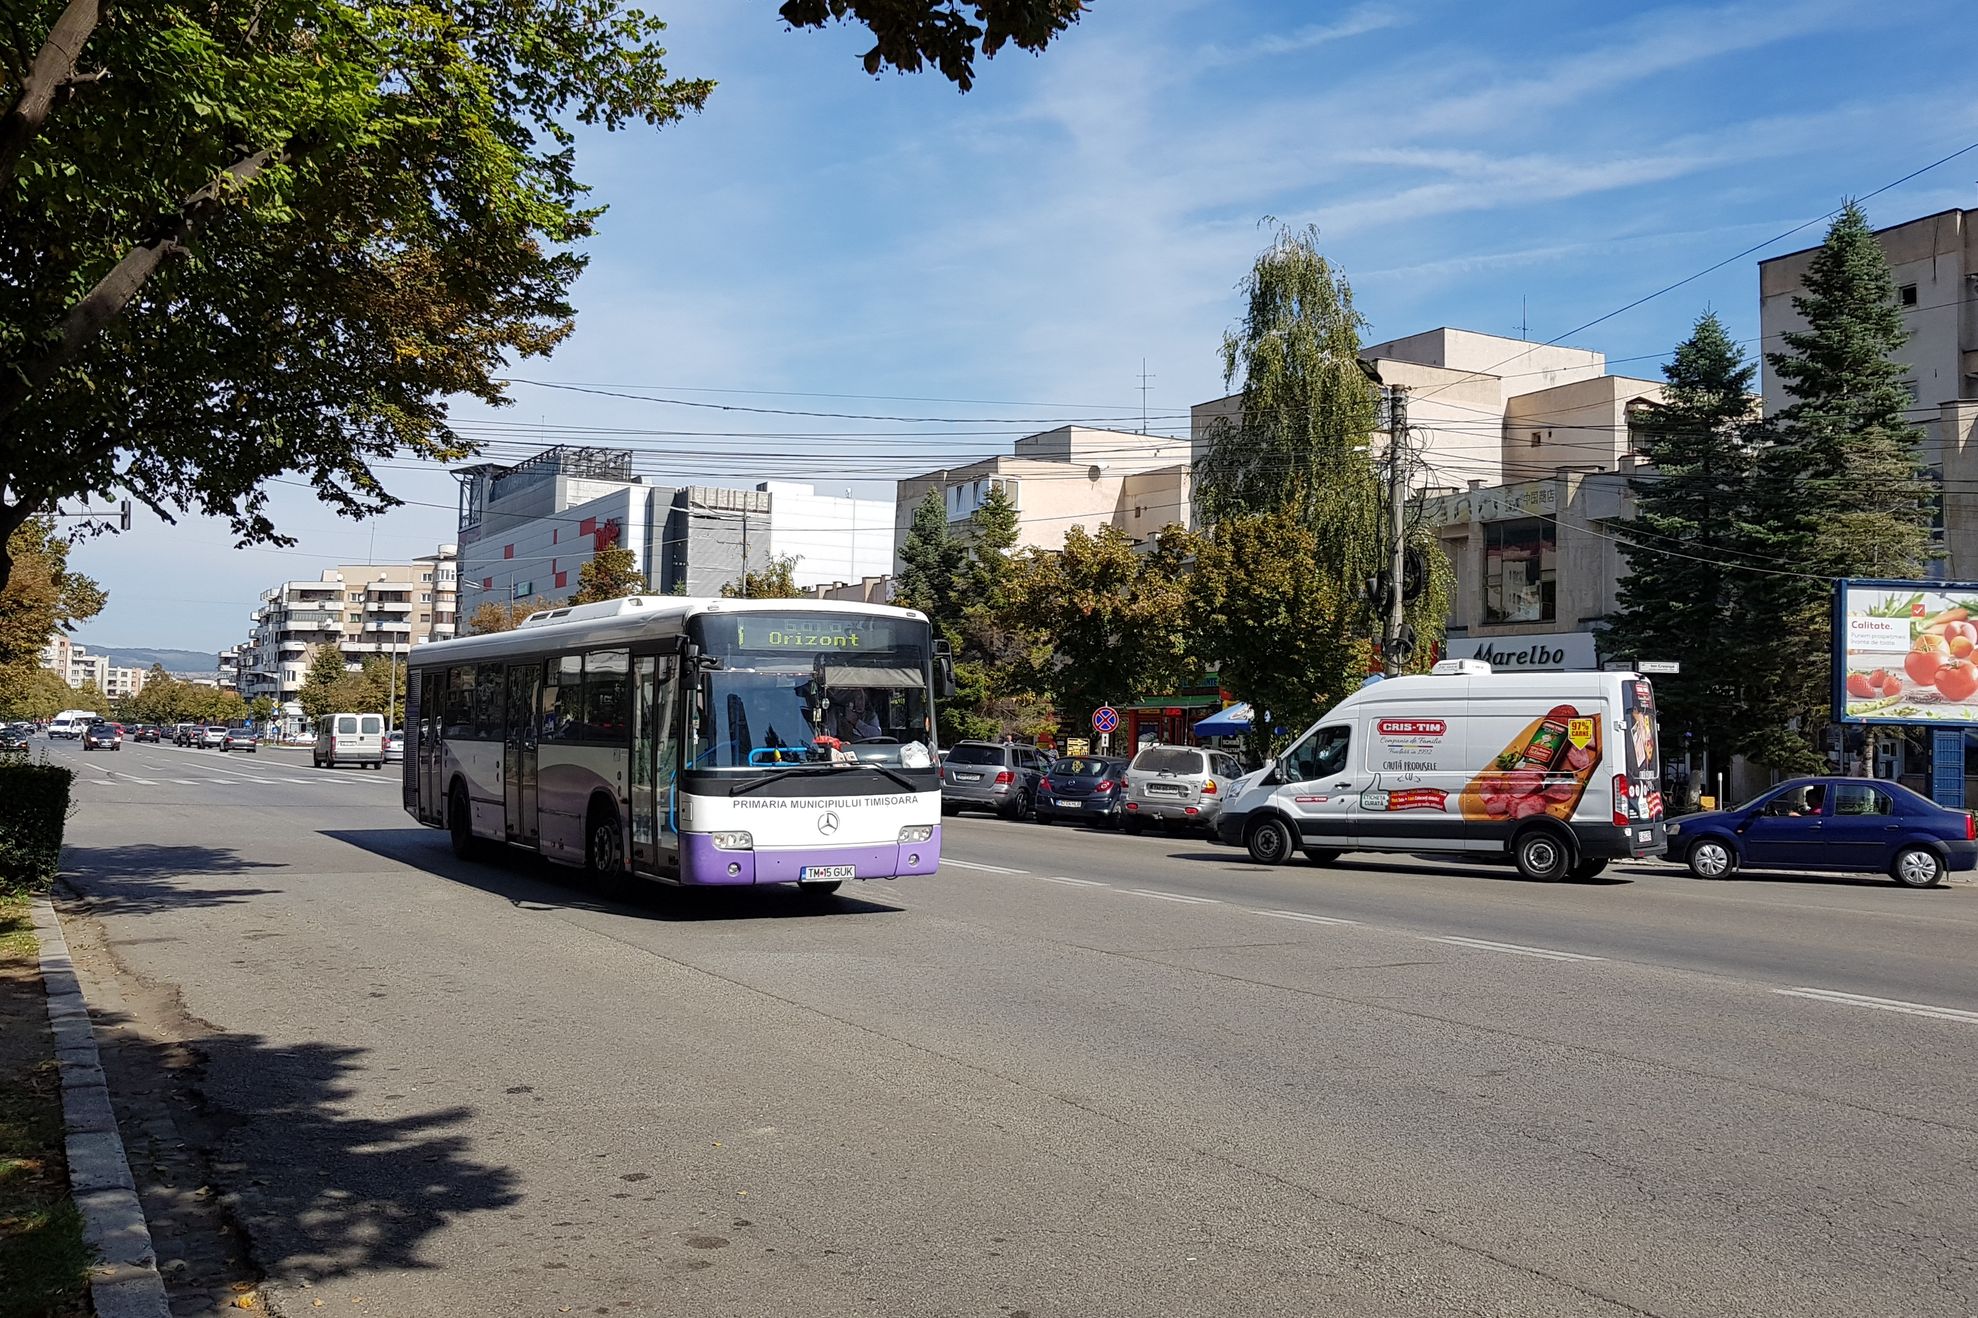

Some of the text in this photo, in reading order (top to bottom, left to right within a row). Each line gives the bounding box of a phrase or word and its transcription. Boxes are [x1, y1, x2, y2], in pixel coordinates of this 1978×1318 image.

[1851, 620, 1893, 630] Calitate.
[769, 631, 859, 647] Orizont
[1473, 642, 1565, 666] Marelbo
[1383, 723, 1441, 732] CRIS-TIM
[1571, 721, 1589, 731] 97%
[1404, 761, 1438, 772] PRODUSELE
[1405, 773, 1414, 781] CU
[790, 800, 862, 809] MUNICIPIULUI
[833, 866, 853, 877] GUK
